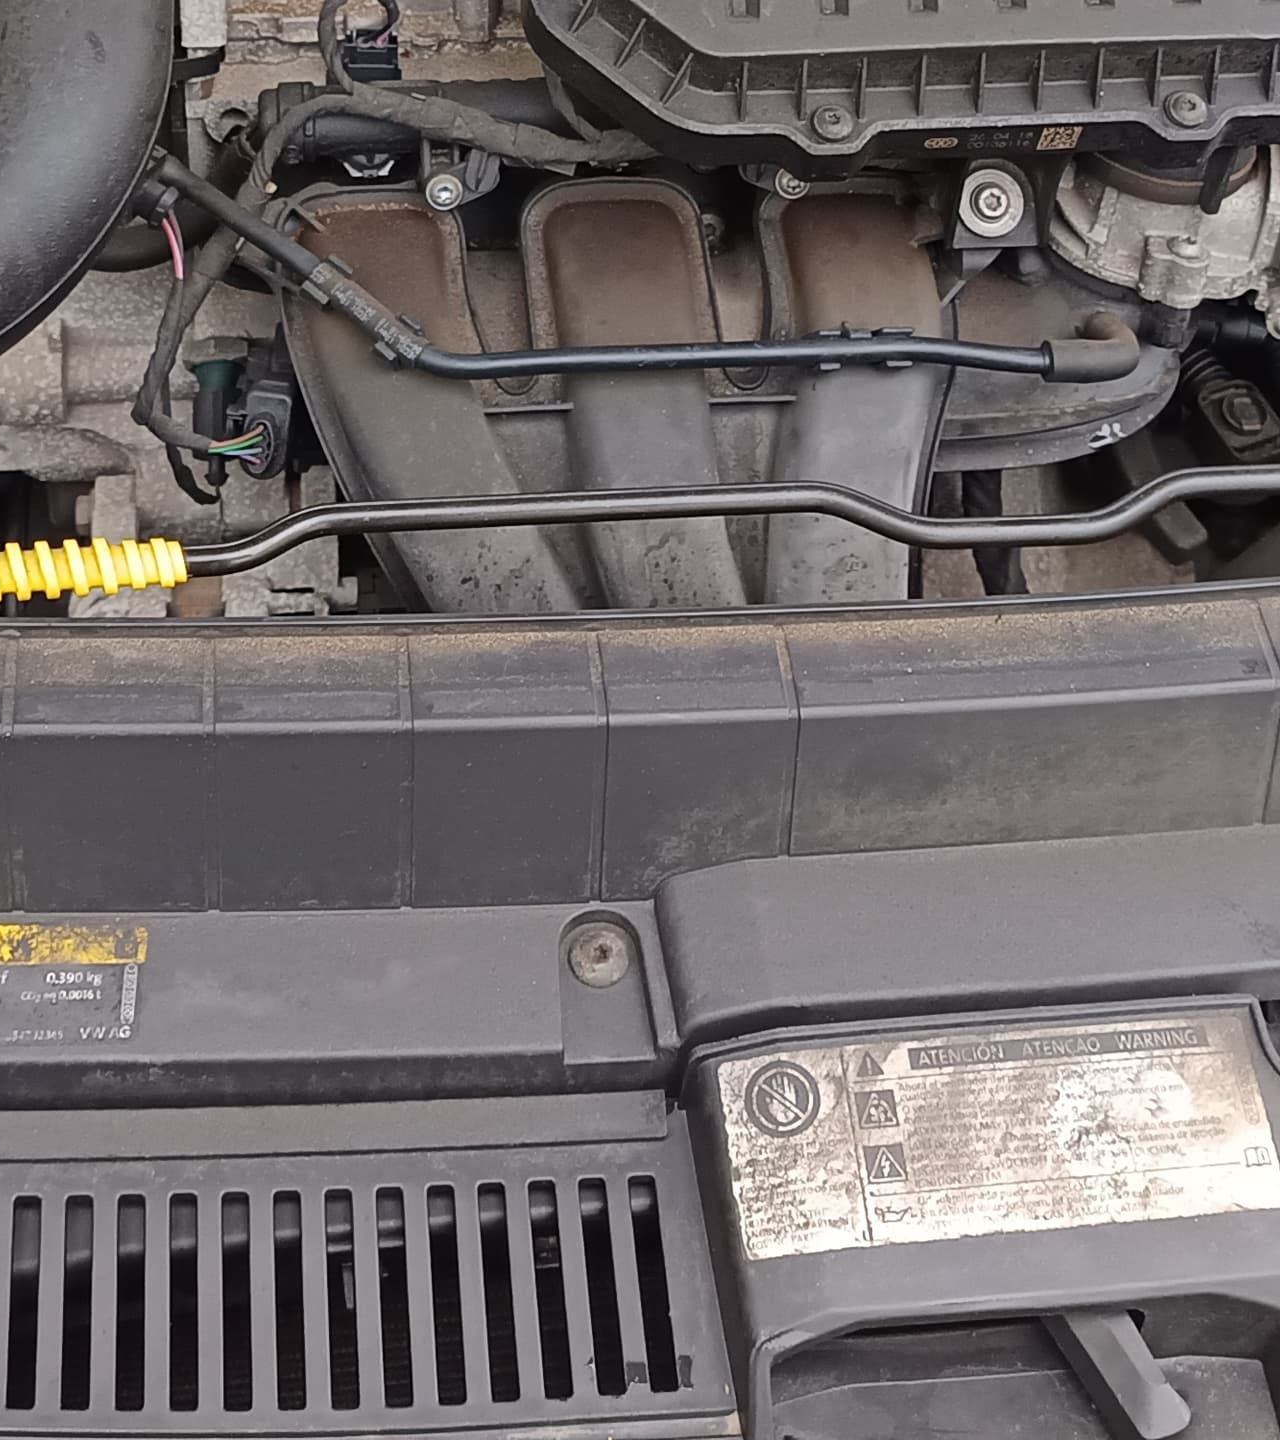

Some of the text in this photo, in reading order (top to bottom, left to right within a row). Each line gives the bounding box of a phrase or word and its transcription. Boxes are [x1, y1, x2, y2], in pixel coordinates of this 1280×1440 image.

[45, 971, 84, 985] 0.390
[918, 1041, 1004, 1067] ATENCIÓN
[1115, 1029, 1198, 1050] WARNING
